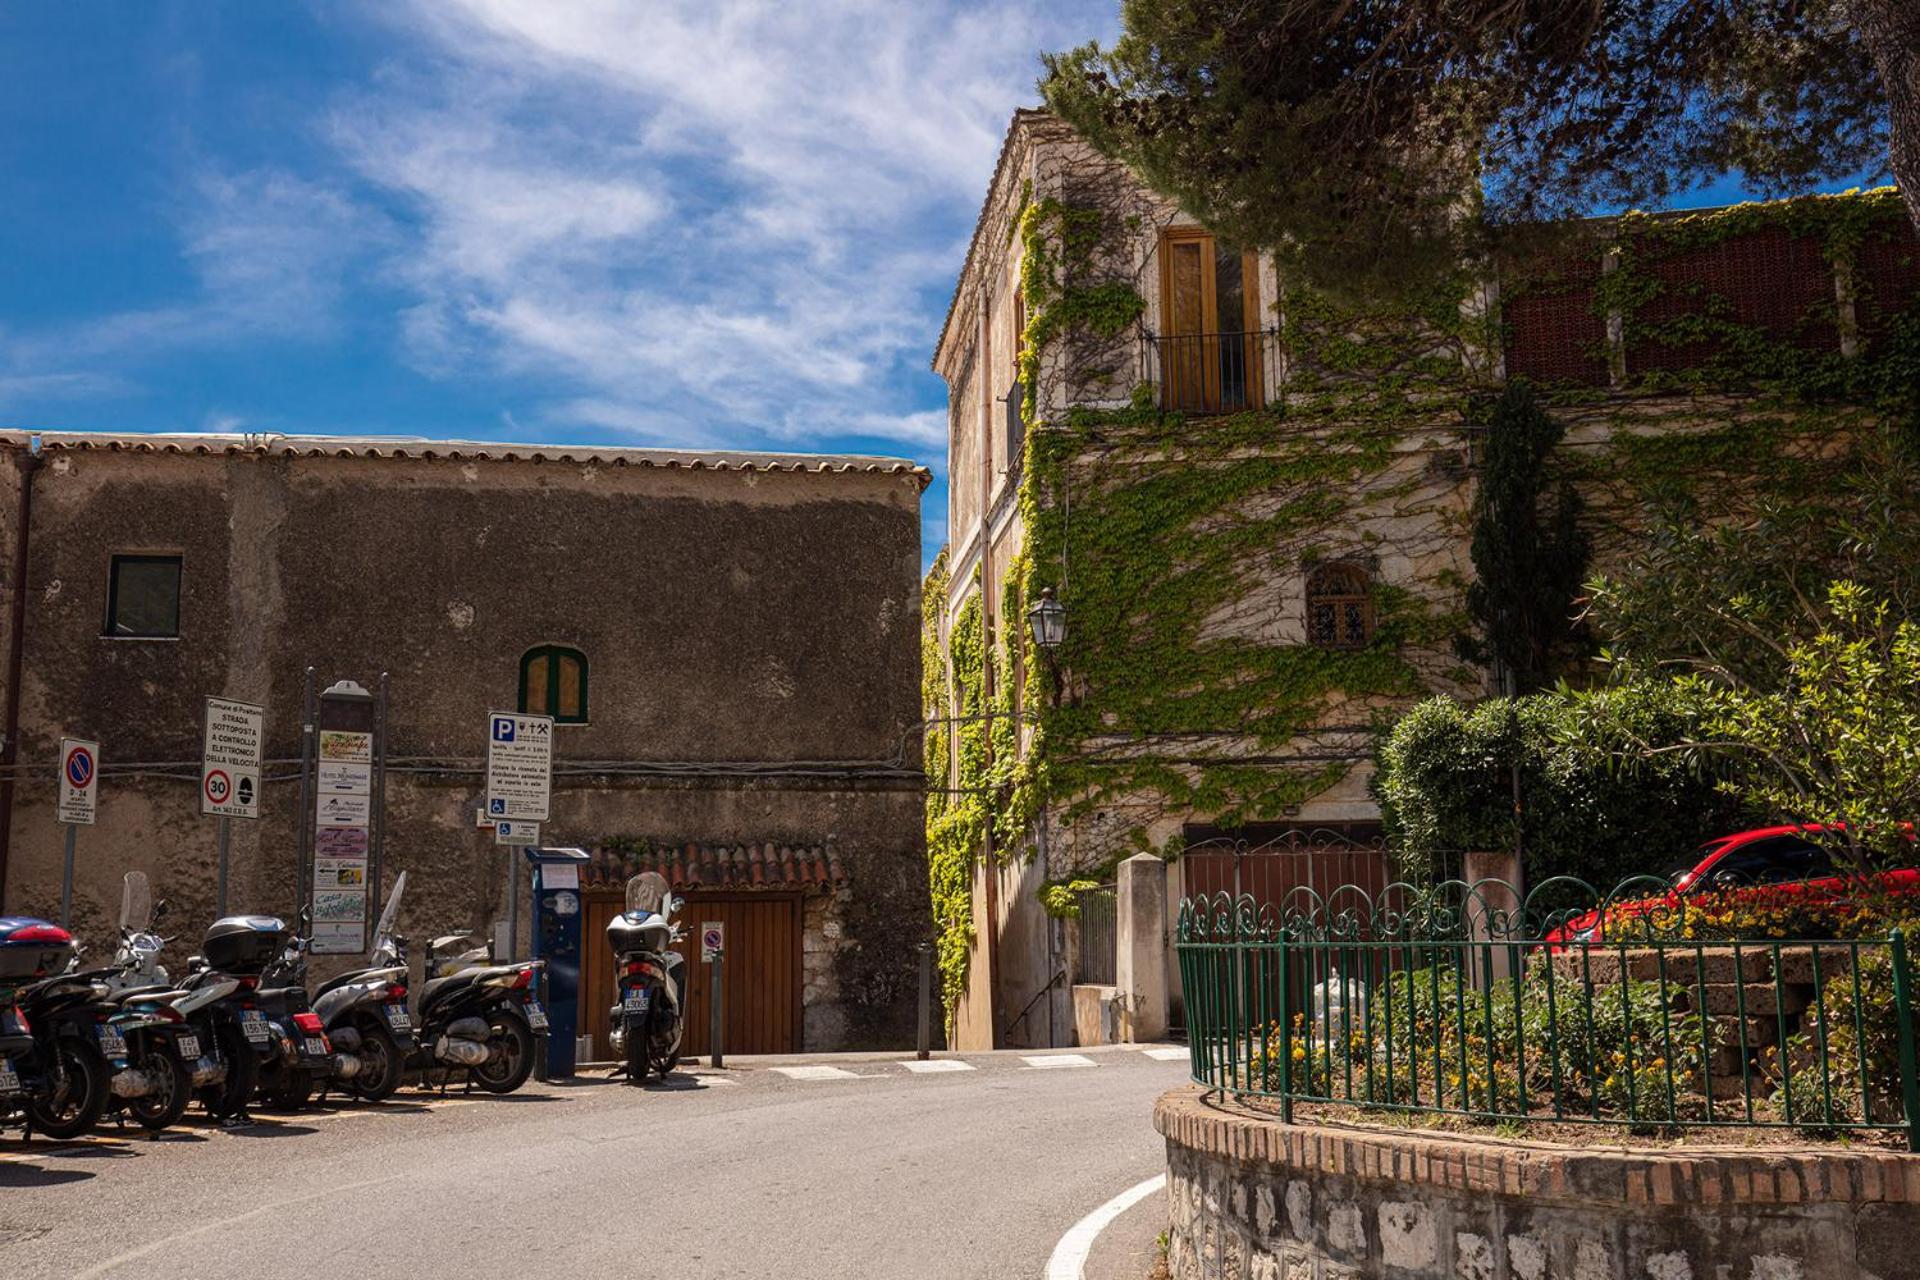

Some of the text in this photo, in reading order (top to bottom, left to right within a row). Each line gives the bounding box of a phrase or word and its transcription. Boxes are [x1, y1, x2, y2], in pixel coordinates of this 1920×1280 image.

[209, 701, 231, 711] Comune
[222, 714, 248, 724] STRADA
[212, 723, 257, 736] SOTTOPOSTA
[498, 720, 513, 740] P
[218, 735, 257, 747] CONTROLLO
[211, 744, 255, 757] ELETTRONICO
[205, 754, 226, 764] DELLA
[210, 780, 226, 794] 30
